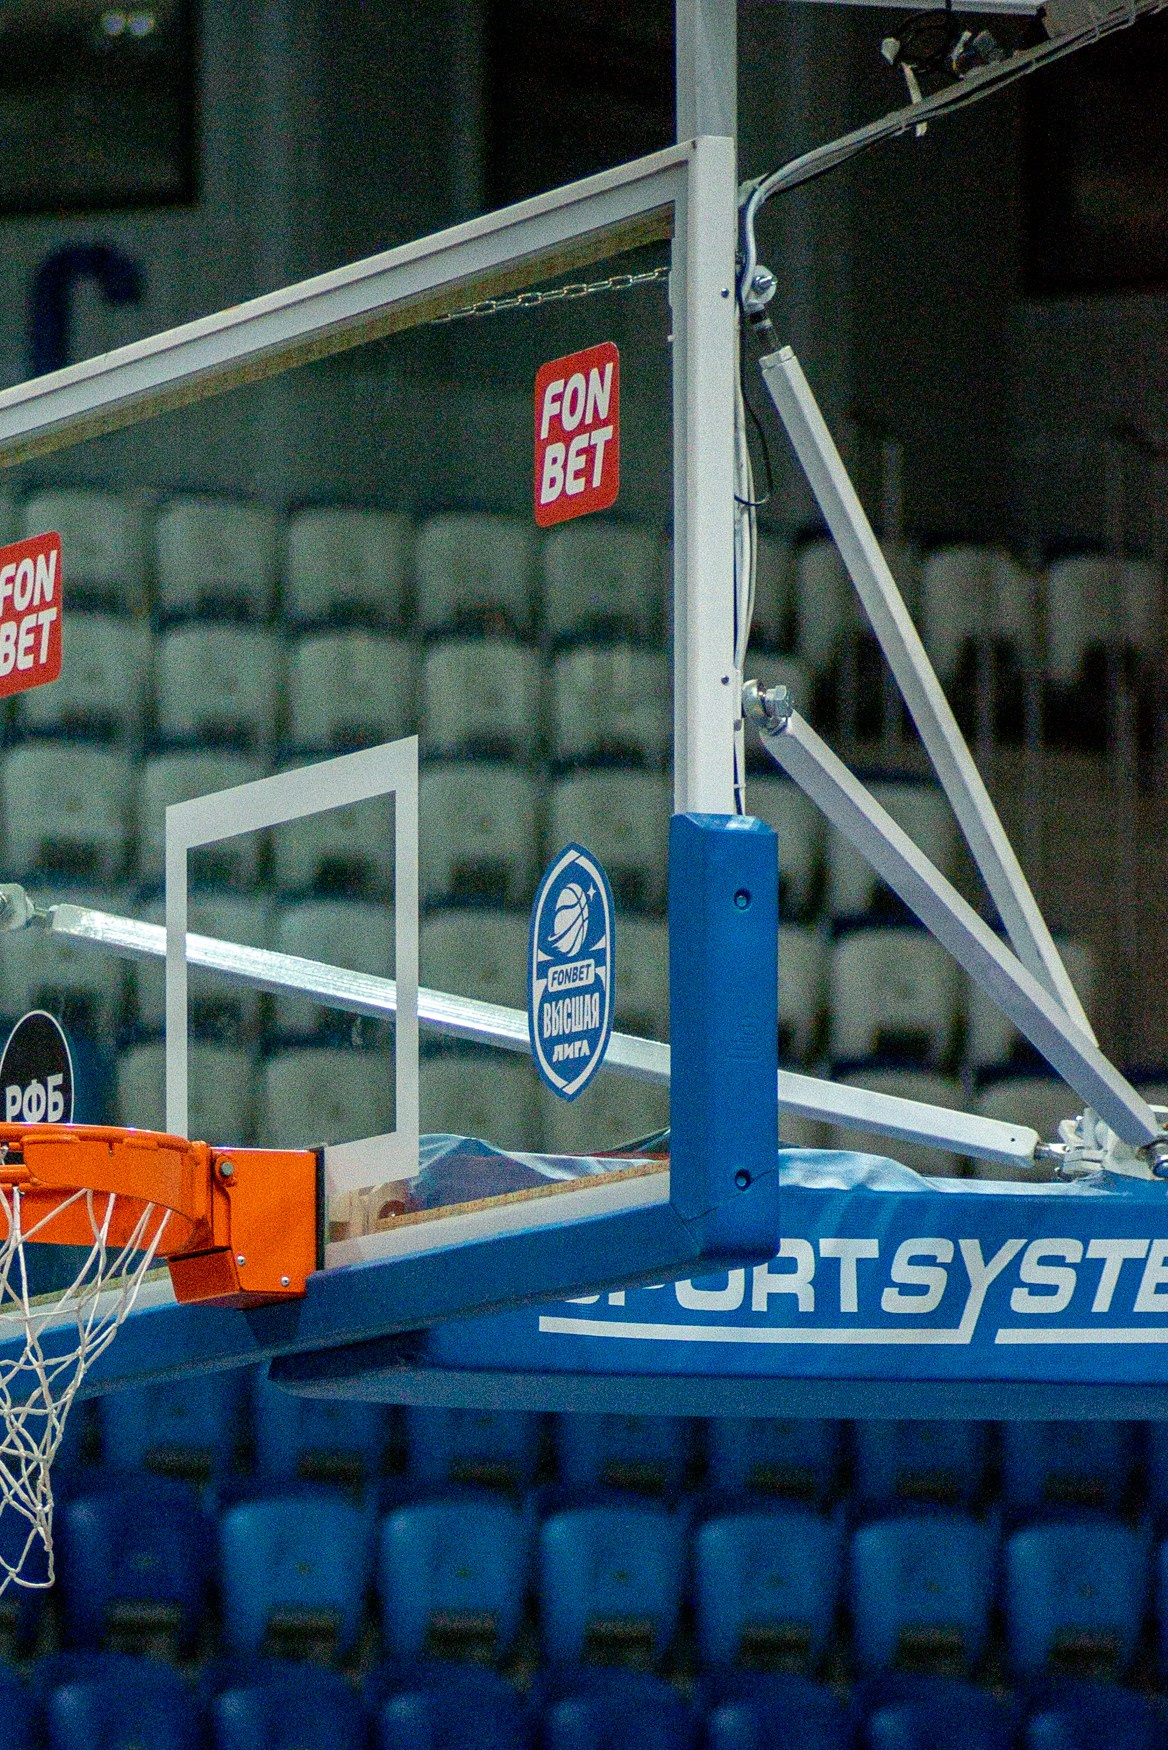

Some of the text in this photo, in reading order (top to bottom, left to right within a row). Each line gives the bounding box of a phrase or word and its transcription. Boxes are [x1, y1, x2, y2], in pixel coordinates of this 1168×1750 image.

[540, 362, 613, 439] FON
[540, 427, 613, 504] BET
[551, 963, 591, 988] FONBET
[543, 993, 600, 1038] ВЫСШАЯ
[552, 1040, 591, 1063] ЛИГА
[6, 1073, 64, 1122] РФБ
